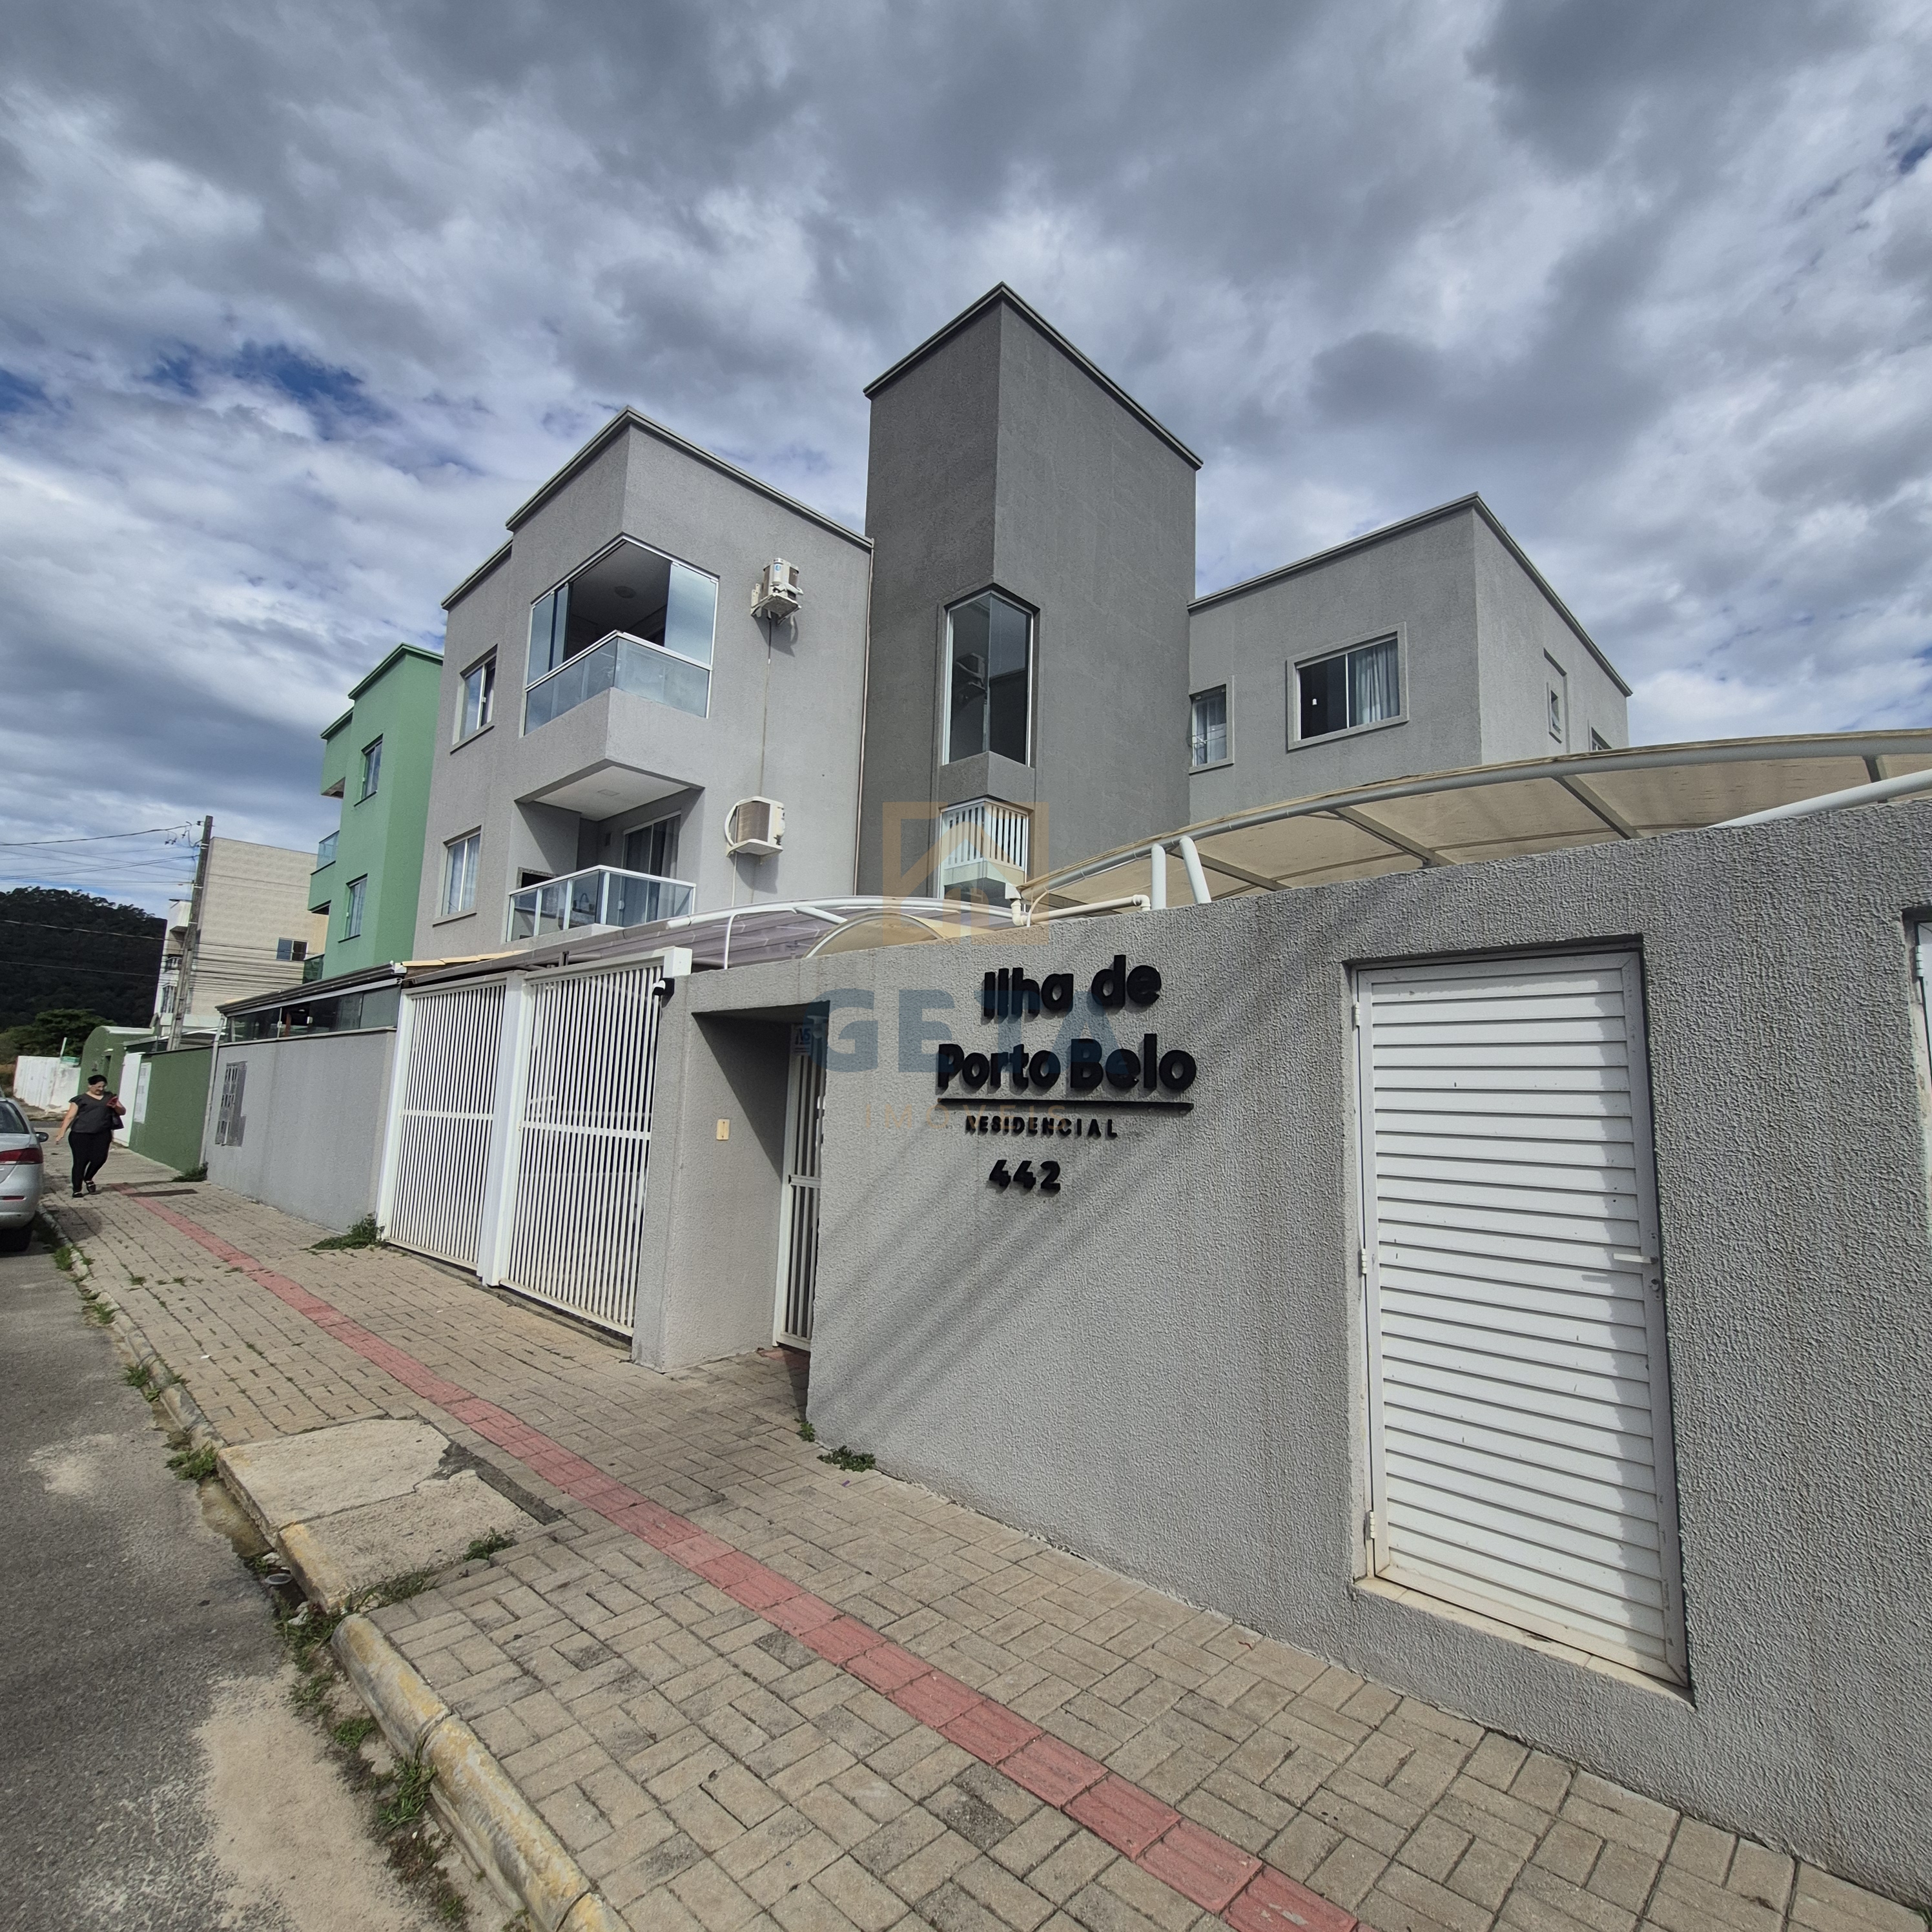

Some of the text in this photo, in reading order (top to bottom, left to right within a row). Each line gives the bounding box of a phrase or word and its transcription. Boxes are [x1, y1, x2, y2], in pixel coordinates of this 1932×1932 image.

[983, 954, 1162, 1018] Ilha de
[938, 1033, 1197, 1091] Porto Belo
[965, 1115, 1118, 1138] RESIDENCIAL
[989, 1160, 1061, 1191] 442
